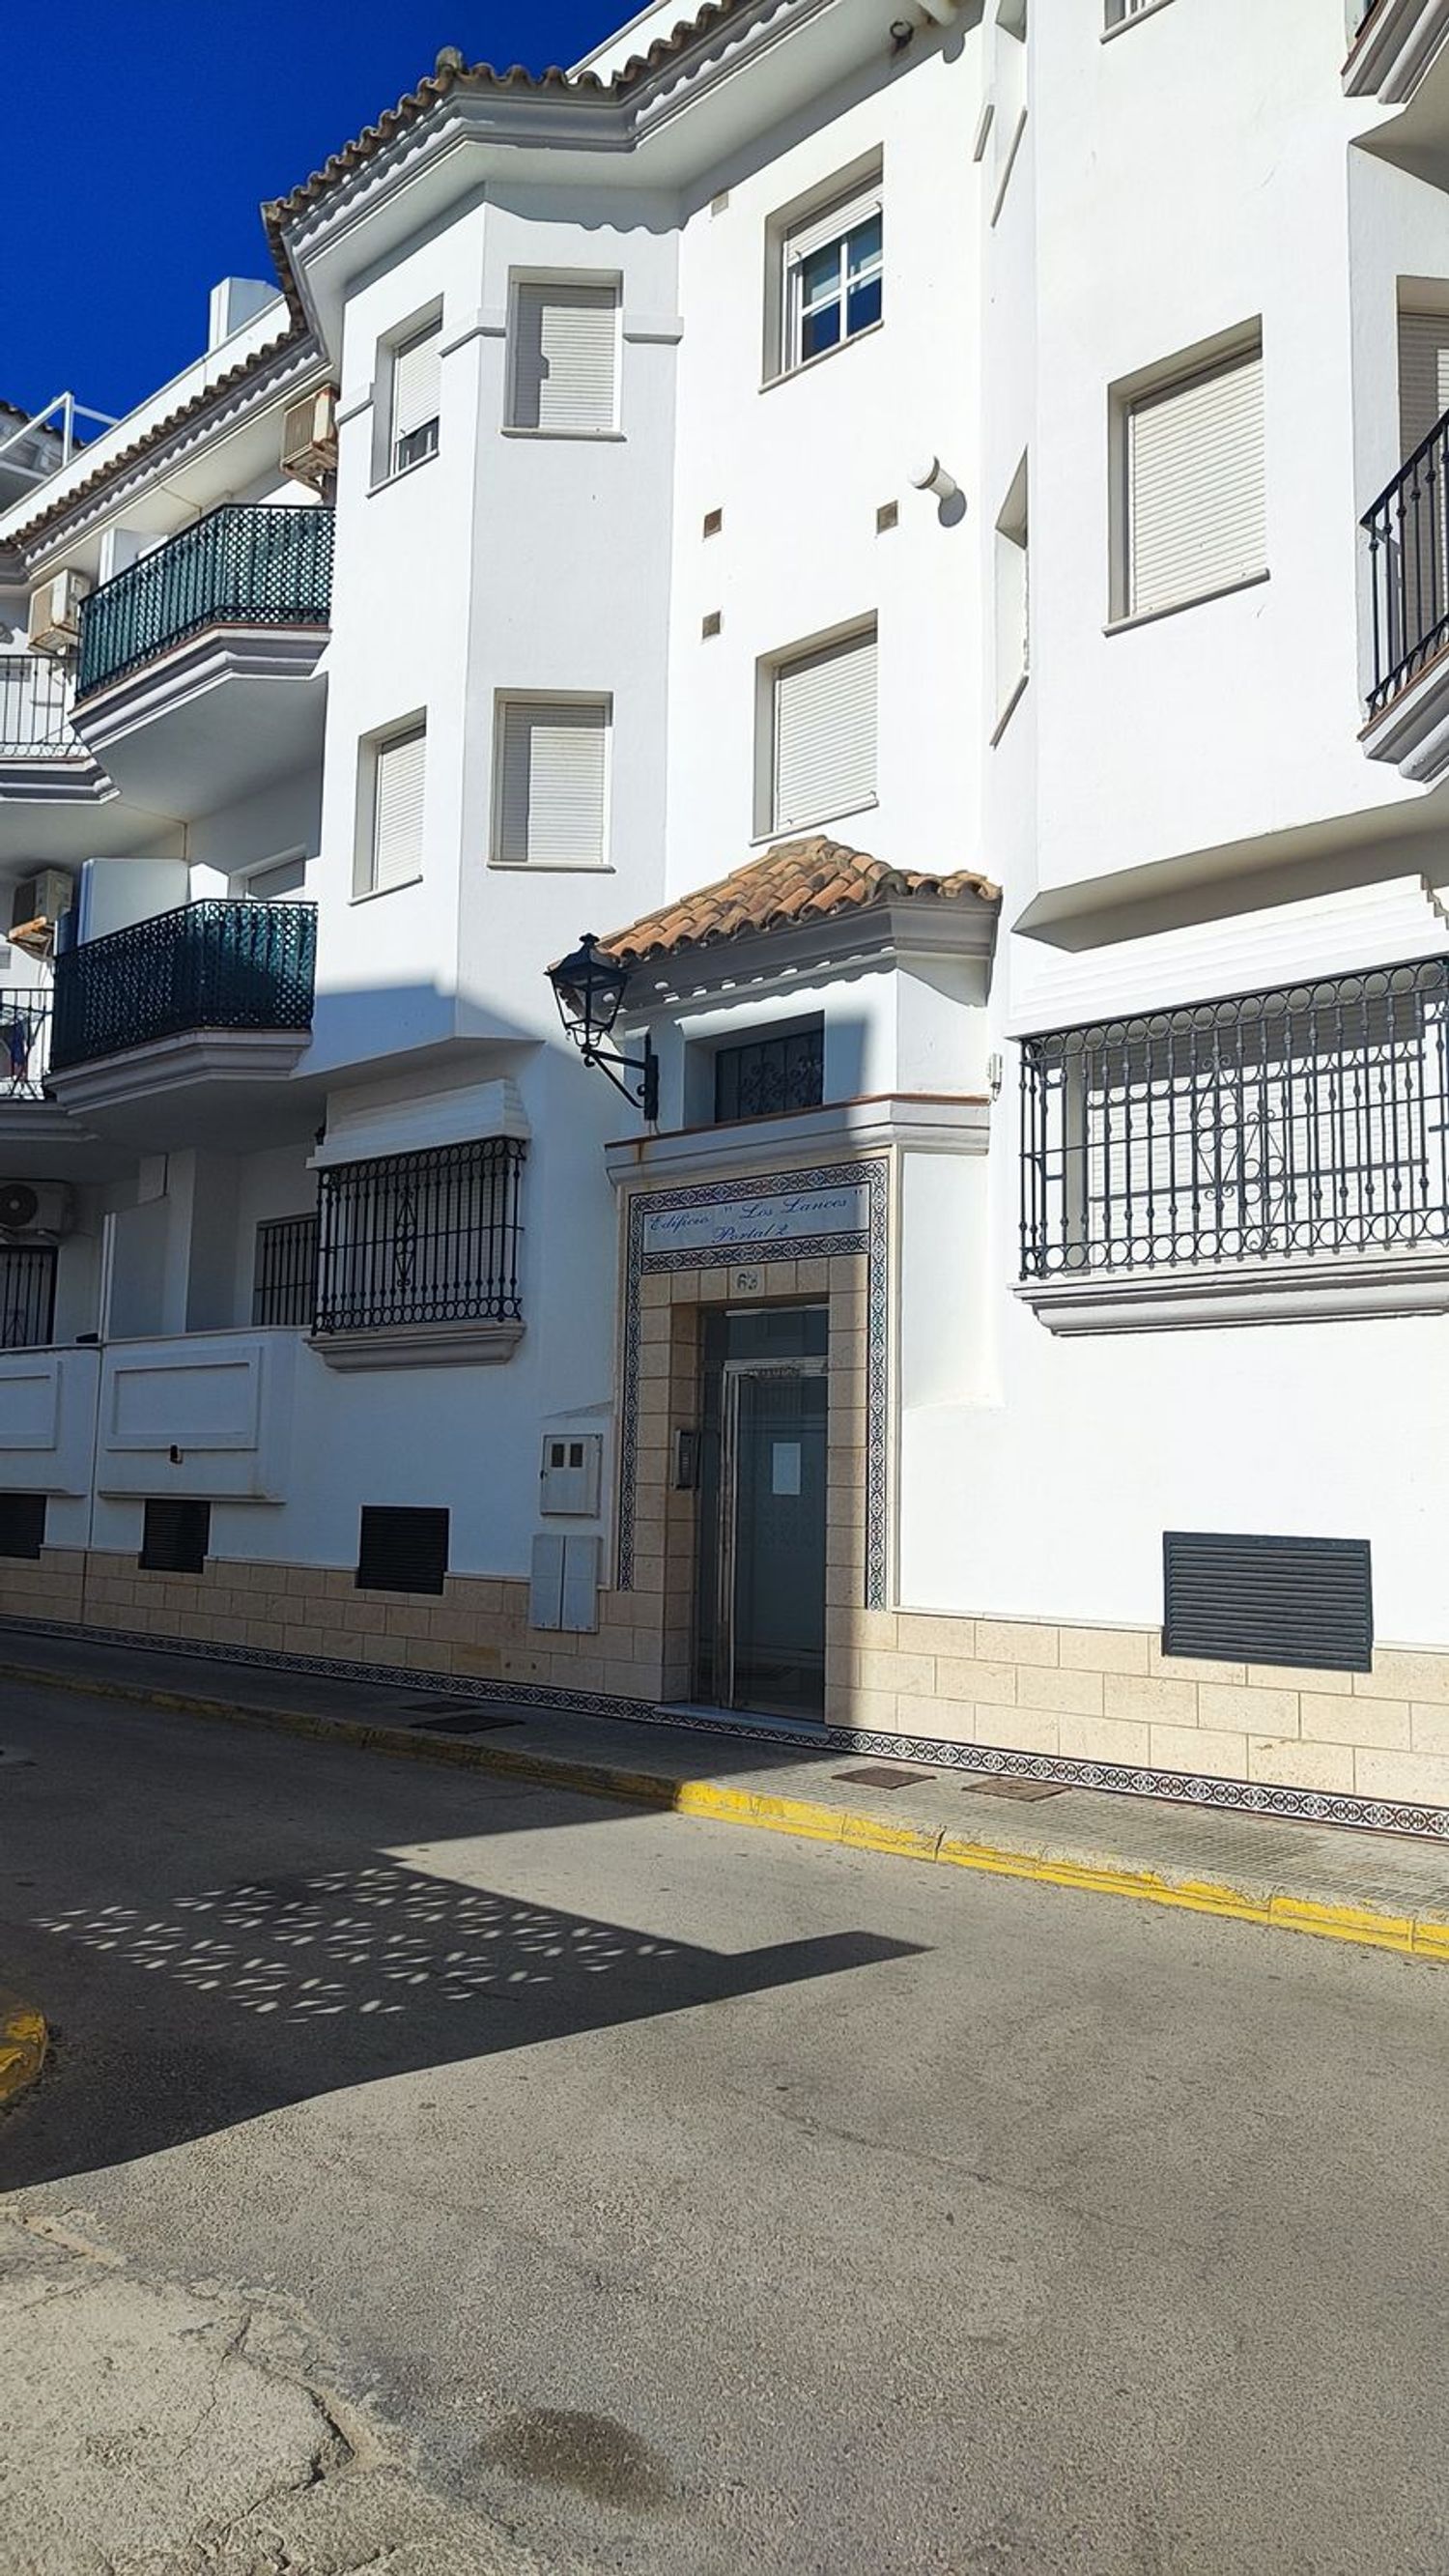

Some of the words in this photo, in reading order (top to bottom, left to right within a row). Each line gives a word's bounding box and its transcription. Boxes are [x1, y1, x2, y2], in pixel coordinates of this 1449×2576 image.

[650, 1213, 710, 1233] Edificio
[712, 1224, 775, 1244] Portal
[777, 1223, 789, 1236] 2
